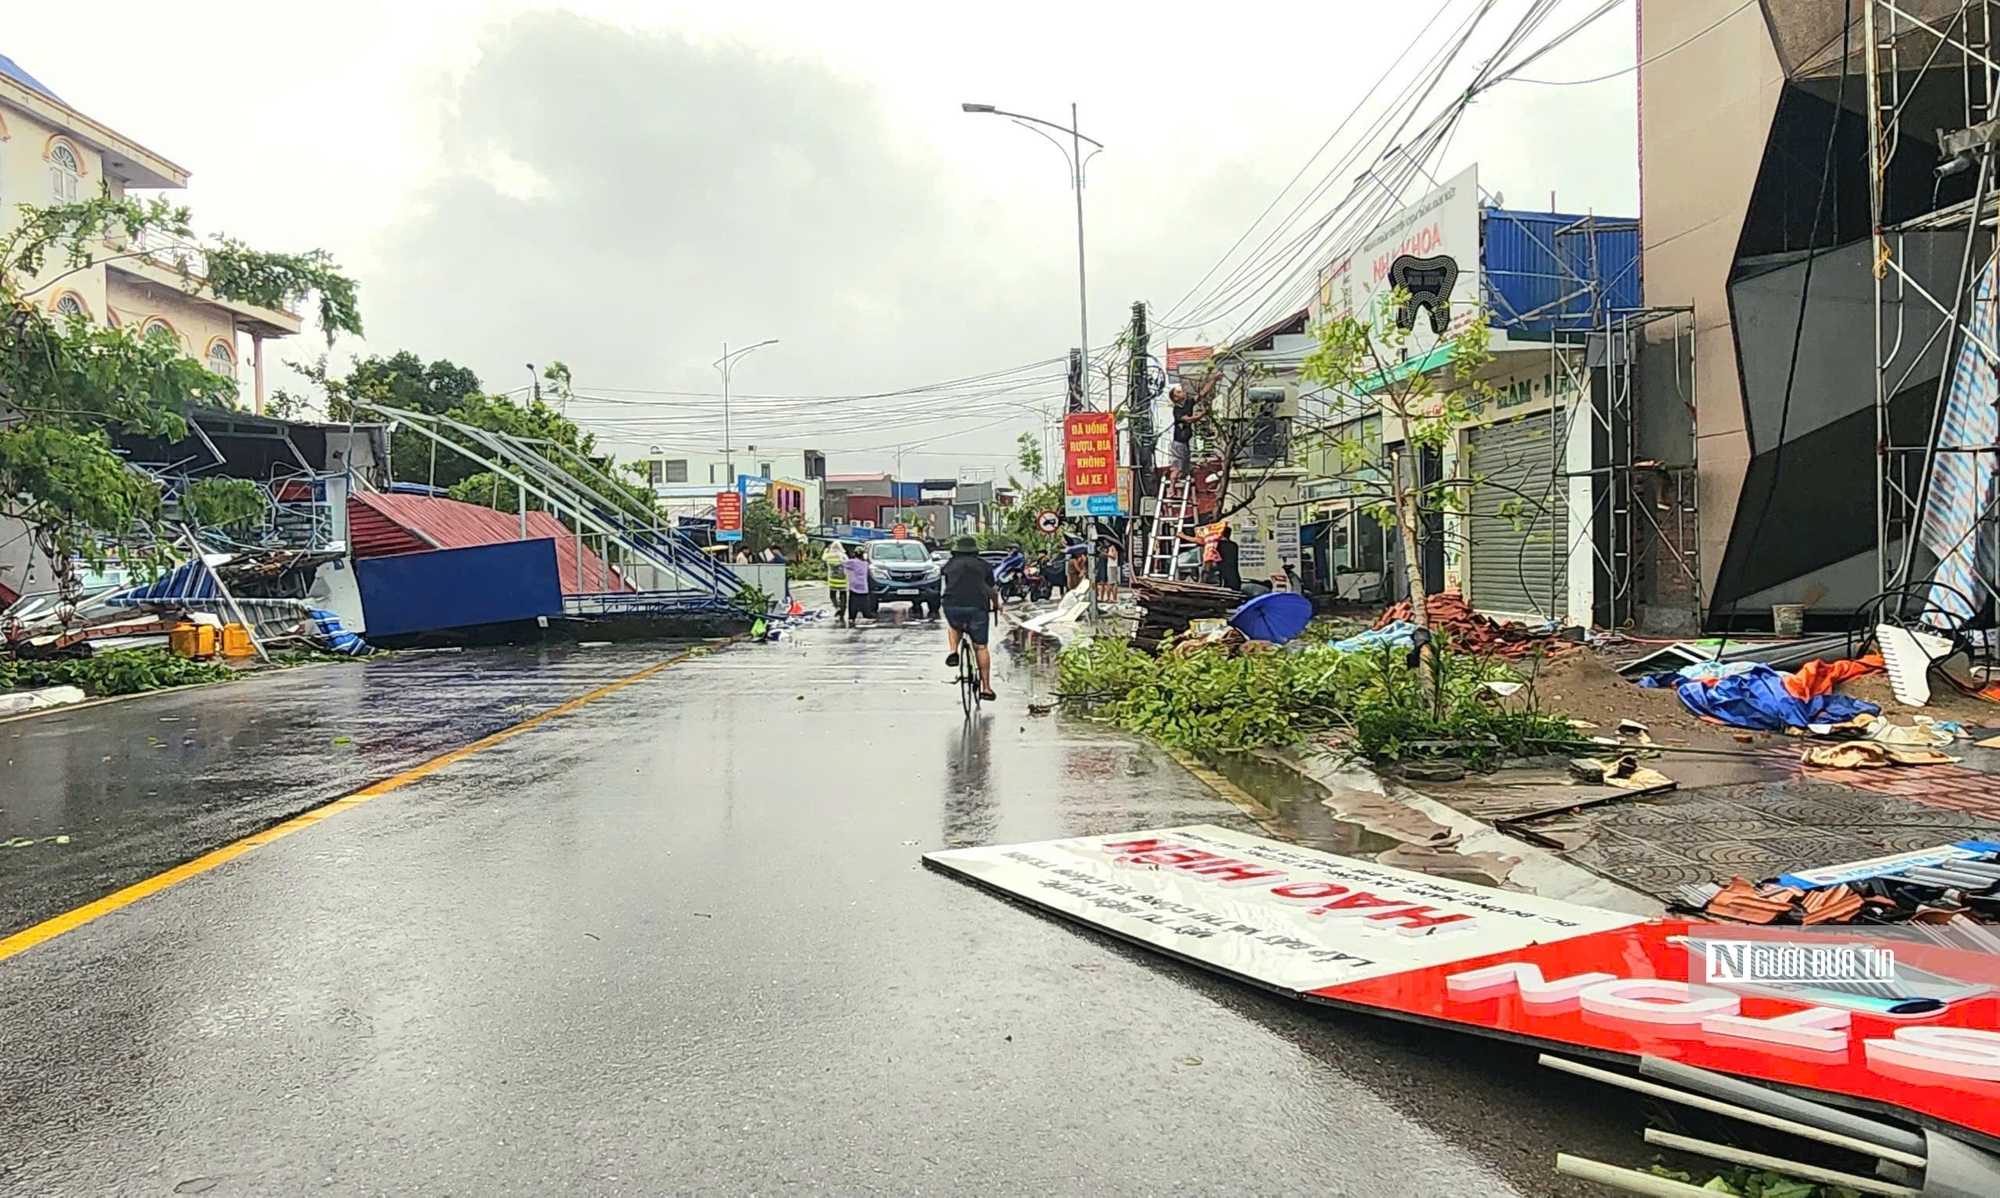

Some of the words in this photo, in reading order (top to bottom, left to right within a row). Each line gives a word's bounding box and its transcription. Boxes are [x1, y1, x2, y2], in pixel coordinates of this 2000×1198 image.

[1085, 420, 1109, 434] UỐNG
[1070, 440, 1096, 454] RƯỢU,
[1096, 440, 1112, 451] BIA
[1077, 455, 1106, 469] KHÔNG
[1076, 472, 1090, 486] LÁI
[1091, 473, 1103, 485] XE
[1132, 894, 1195, 914] CÔNG
[1270, 881, 1478, 929] HÀO
[1189, 912, 1236, 927] THI
[1311, 949, 1376, 967] LẮP
